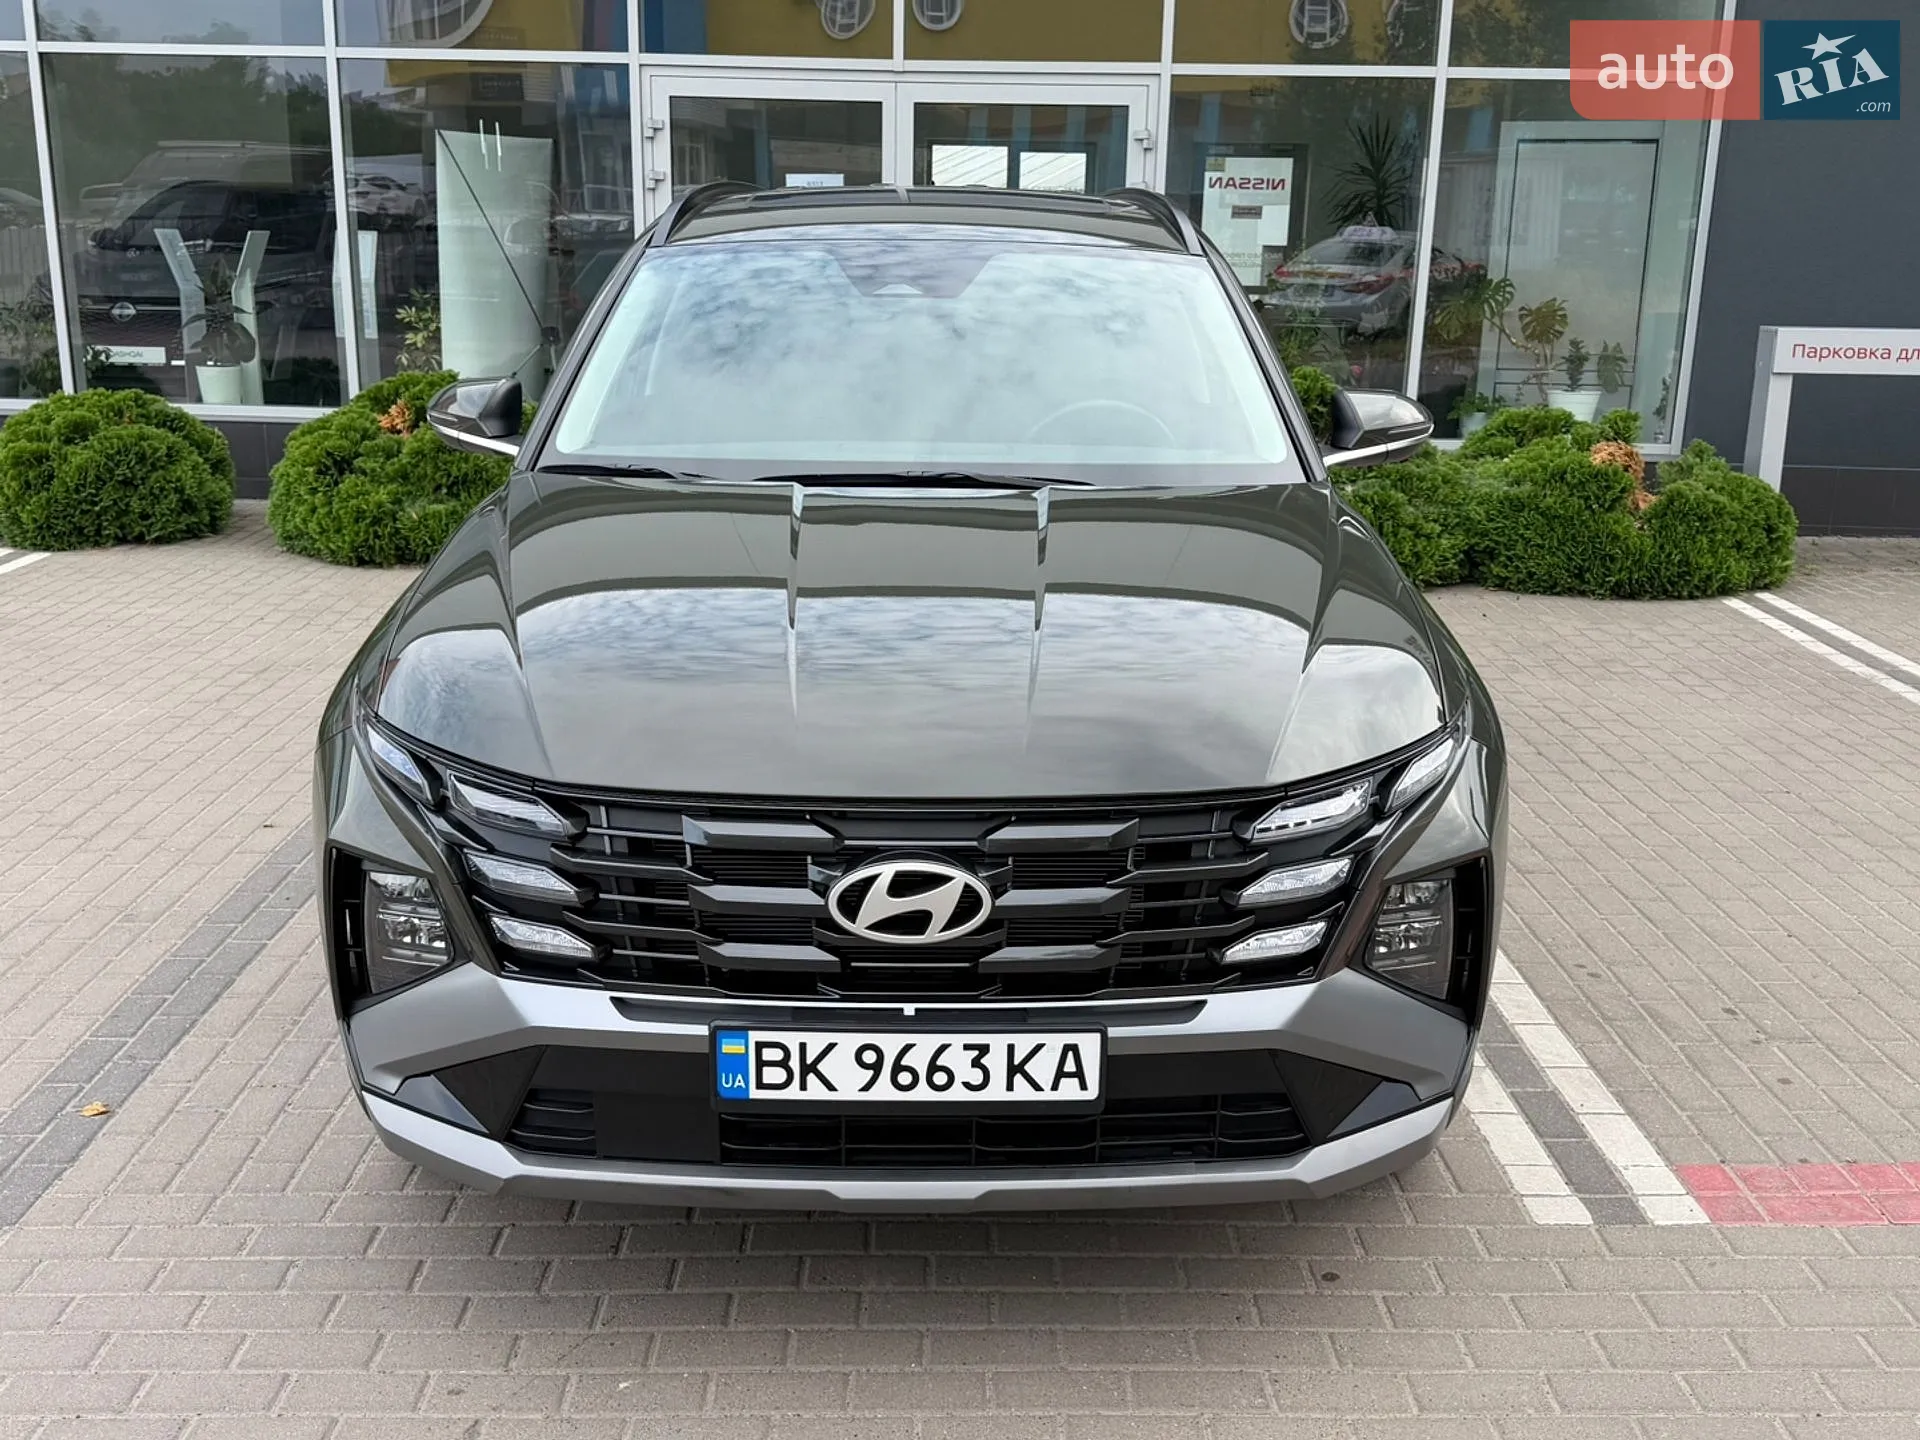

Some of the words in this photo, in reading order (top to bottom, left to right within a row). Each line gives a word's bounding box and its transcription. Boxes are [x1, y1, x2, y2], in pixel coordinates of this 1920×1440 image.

[1792, 343, 1891, 362] Парковка
[754, 1041, 838, 1091] BK
[854, 1043, 990, 1091] 9663
[1005, 1043, 1088, 1091] KA
[722, 1074, 745, 1088] UA
